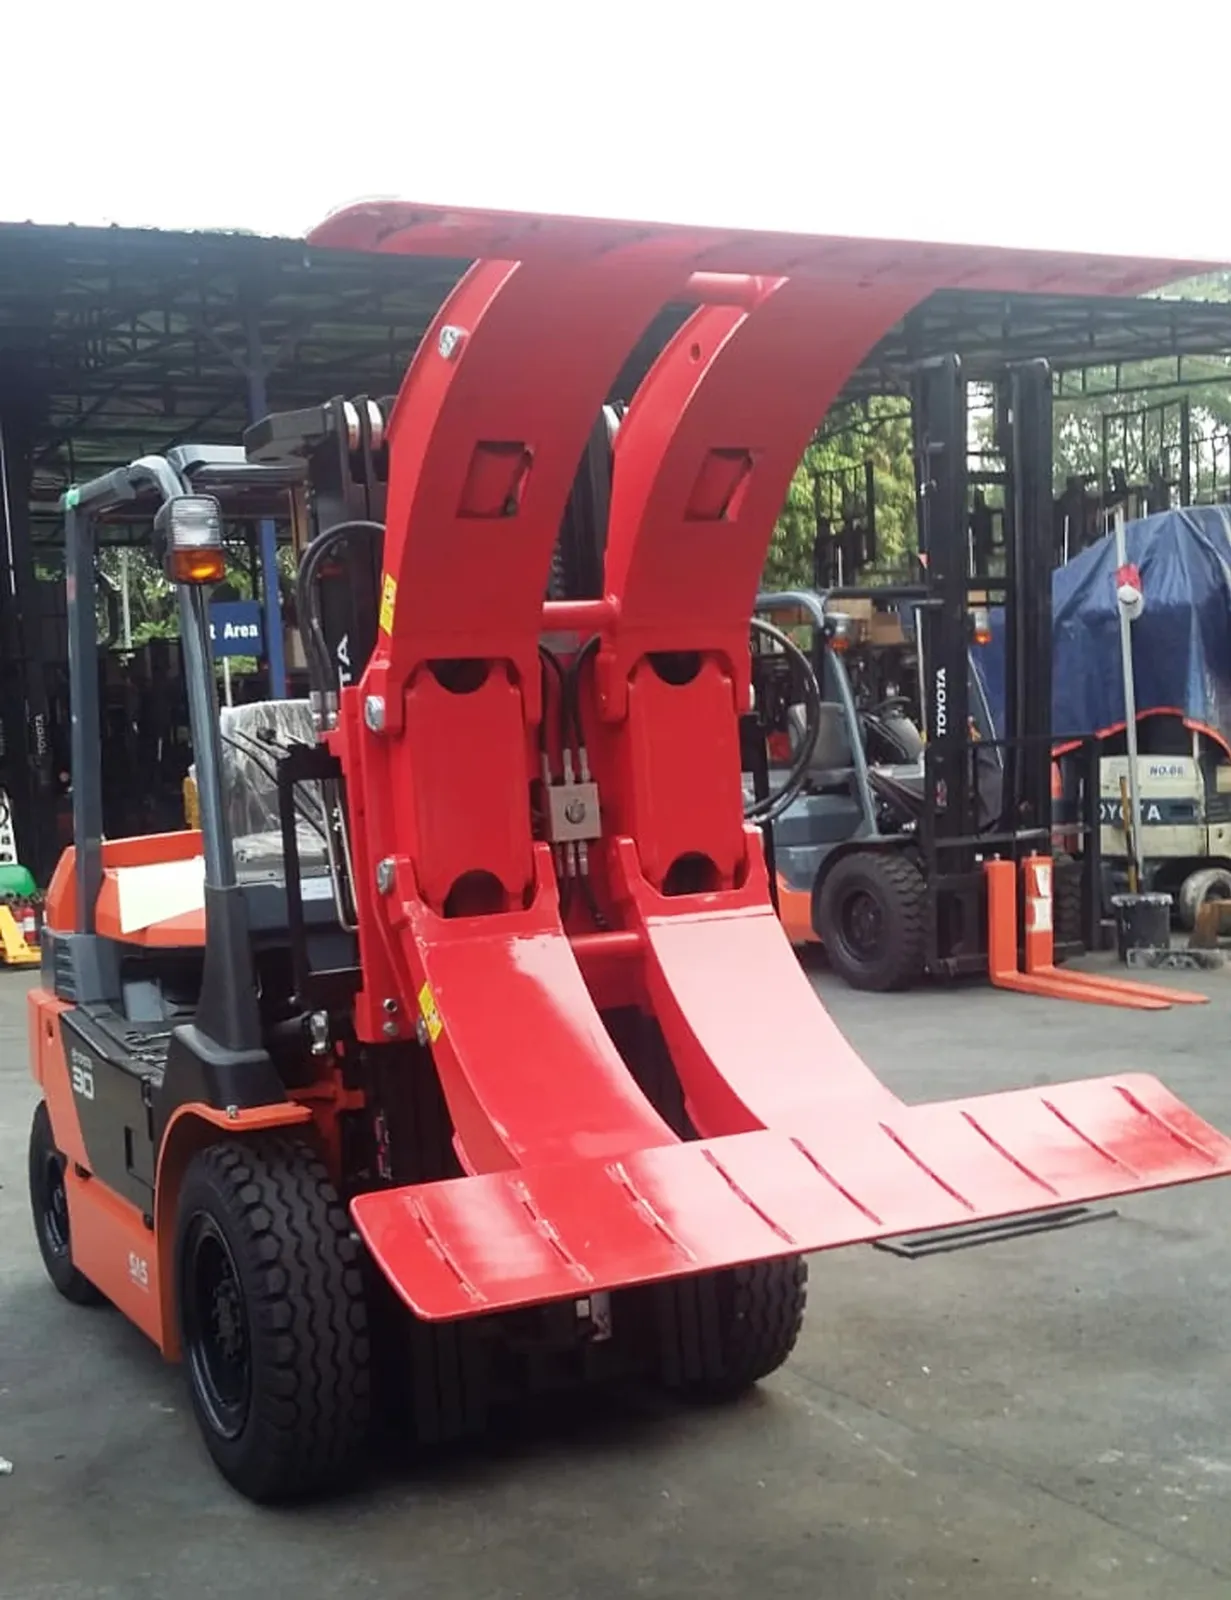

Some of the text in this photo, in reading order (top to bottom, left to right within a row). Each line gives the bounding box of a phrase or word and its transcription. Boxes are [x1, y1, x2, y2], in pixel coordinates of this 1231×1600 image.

[223, 621, 259, 640] Area
[936, 666, 947, 738] TOYOTA
[35, 713, 47, 756] TOYOTA
